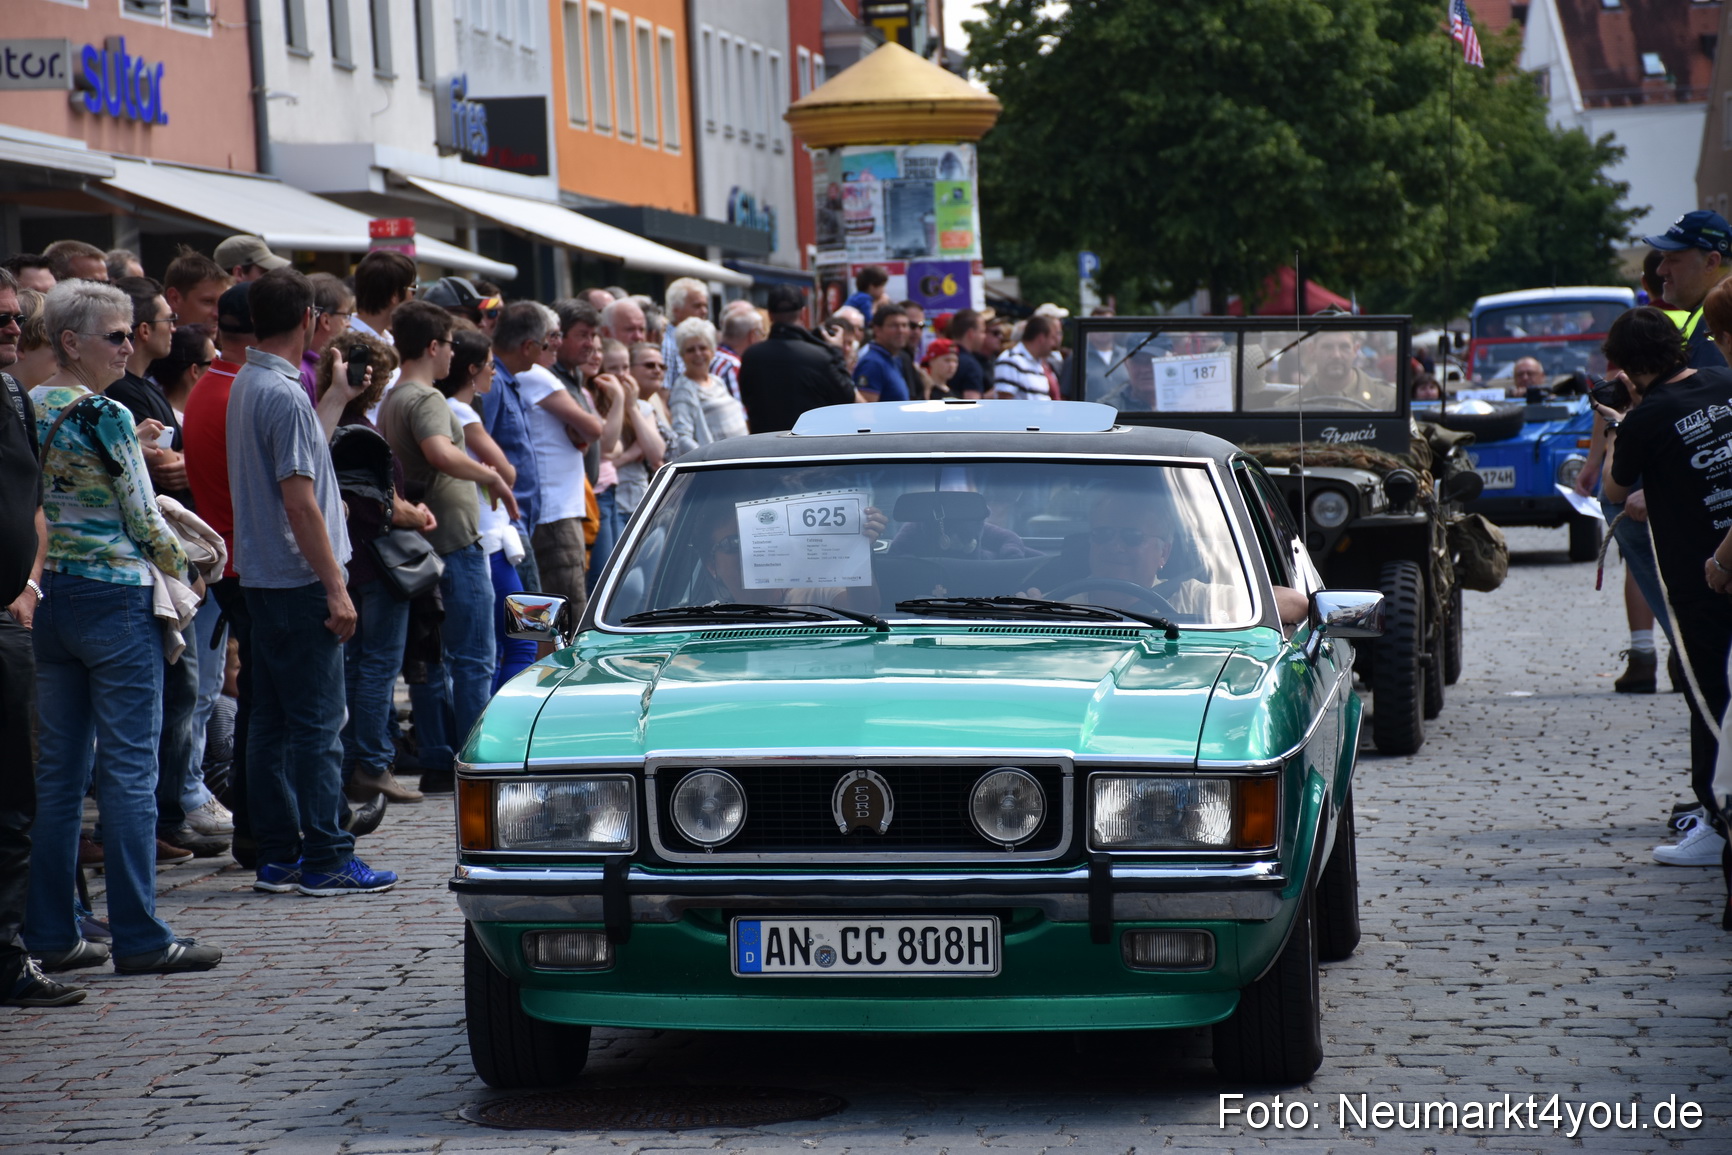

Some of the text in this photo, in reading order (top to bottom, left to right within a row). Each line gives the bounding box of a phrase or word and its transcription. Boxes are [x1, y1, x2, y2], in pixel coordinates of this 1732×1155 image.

[0, 46, 63, 79] tor.
[81, 35, 168, 125] sutor.
[1193, 365, 1217, 380] 187
[1321, 423, 1377, 444] Francis
[802, 506, 847, 527] 625
[854, 785, 870, 818] FORD
[745, 951, 755, 963] D
[765, 926, 990, 966] AN CC 808H
